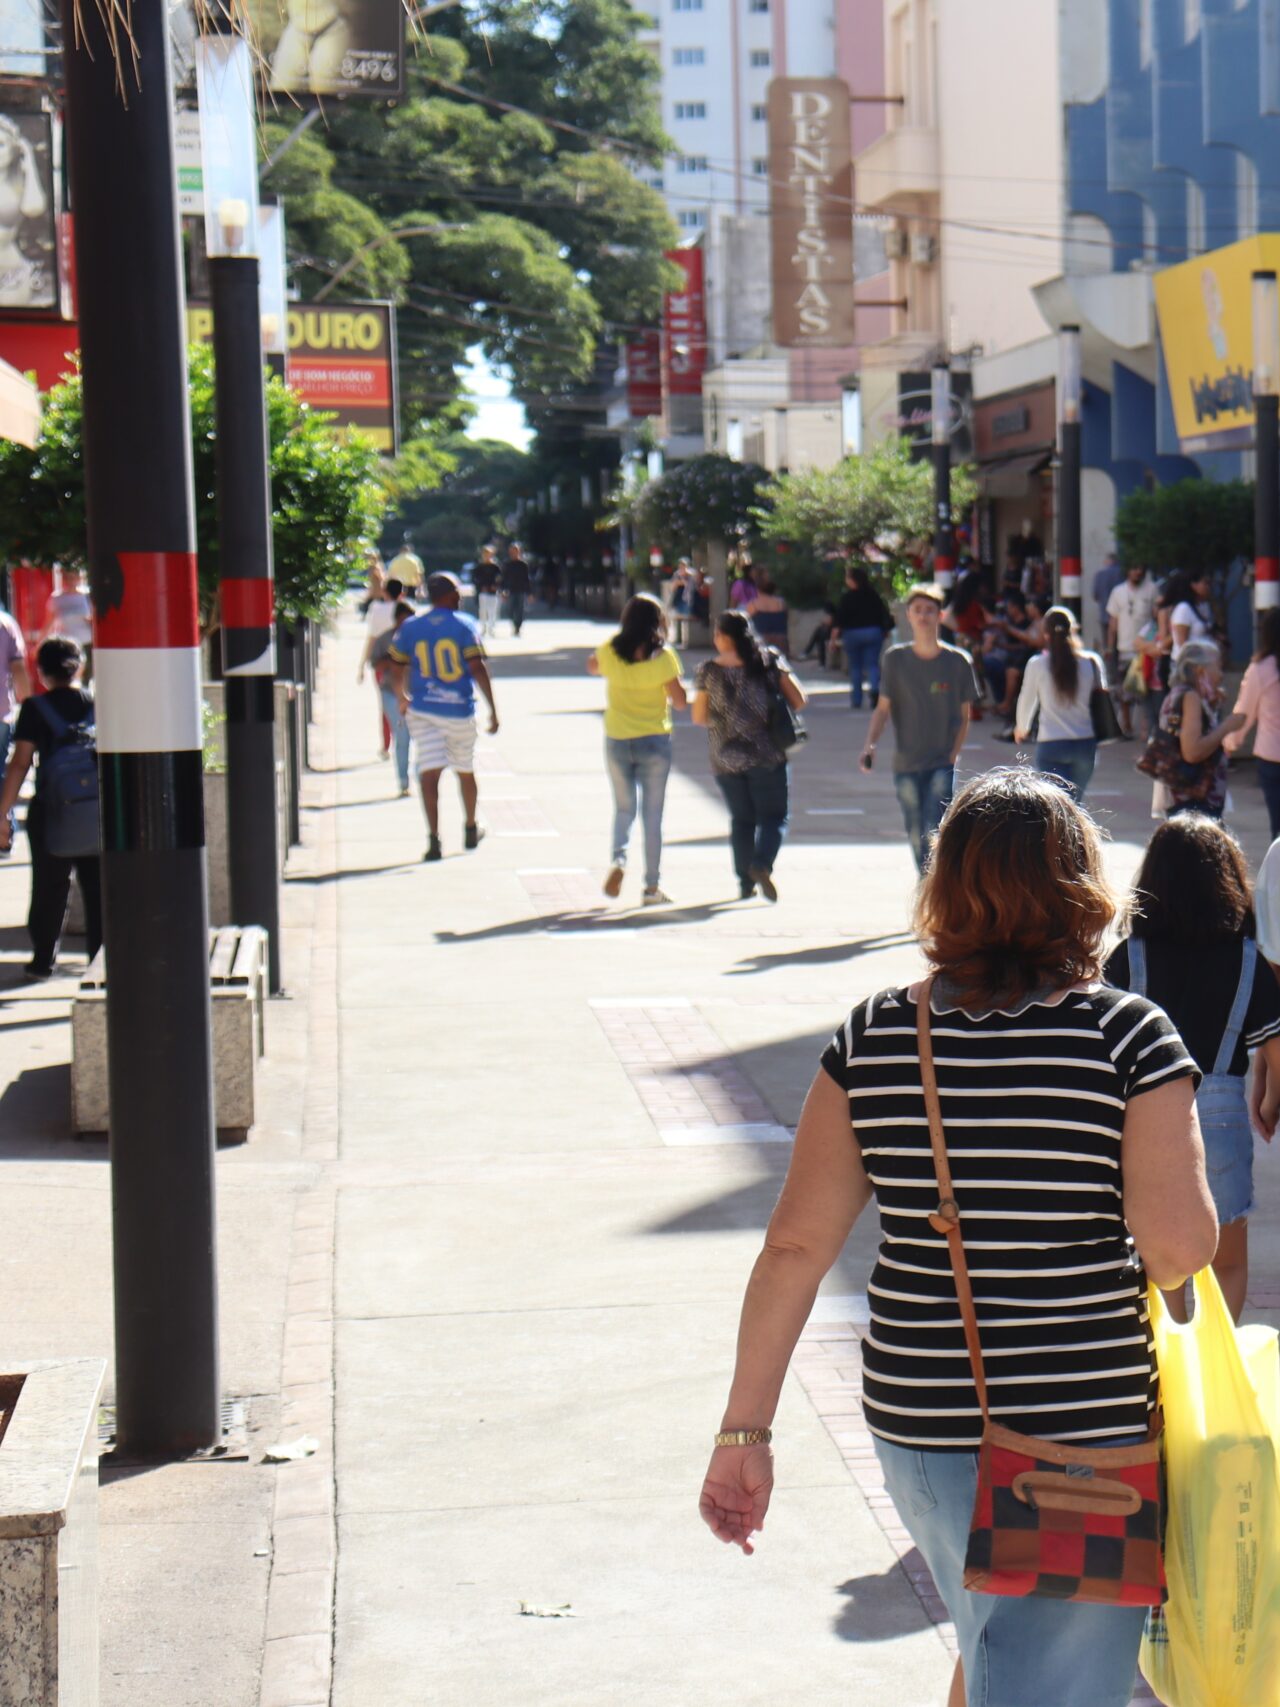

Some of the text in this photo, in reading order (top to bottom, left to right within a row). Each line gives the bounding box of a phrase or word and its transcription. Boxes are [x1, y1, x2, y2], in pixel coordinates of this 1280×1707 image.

[341, 57, 397, 82] 8496
[789, 91, 834, 334] DENTISTAS
[415, 638, 463, 682] 10
